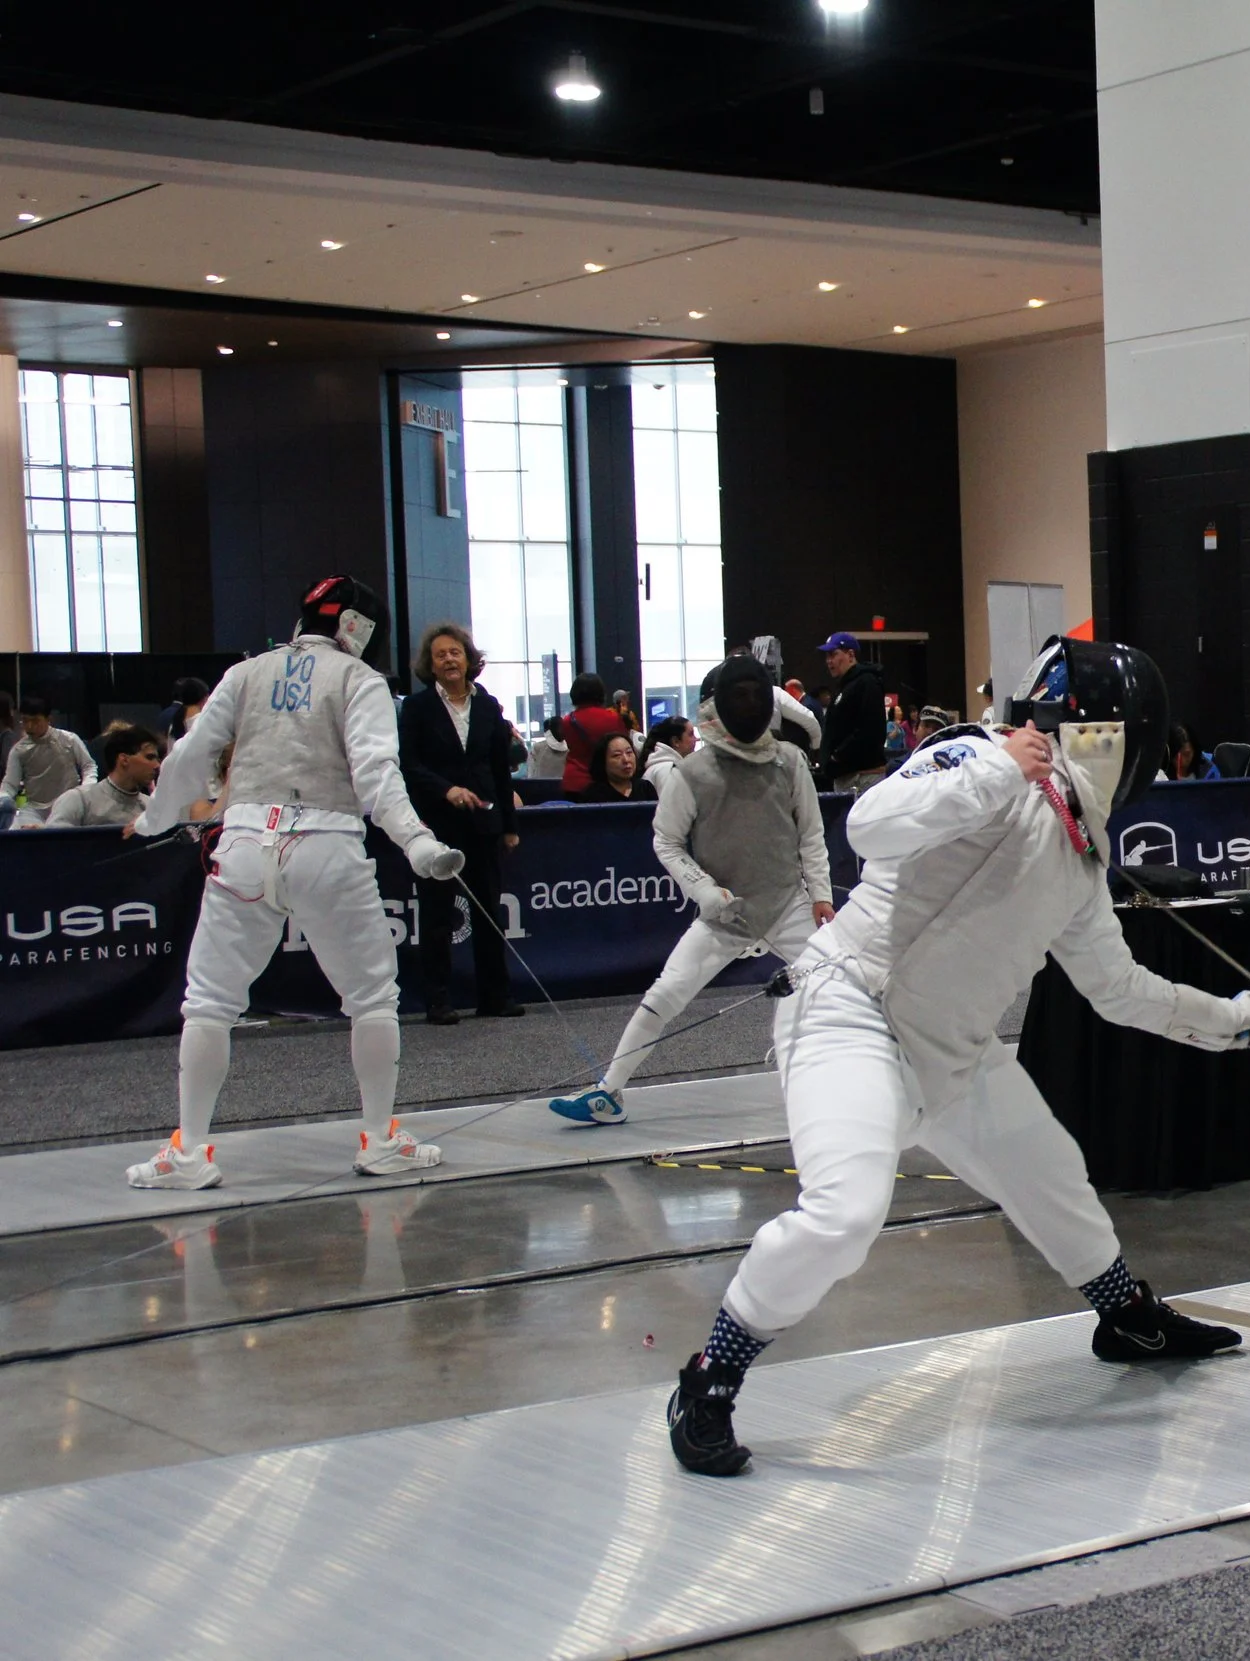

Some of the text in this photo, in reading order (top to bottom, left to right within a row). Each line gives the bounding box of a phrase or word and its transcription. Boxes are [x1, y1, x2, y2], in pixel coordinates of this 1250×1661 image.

[437, 431, 461, 518] E
[285, 654, 316, 684] VO
[271, 679, 312, 712] USA
[6, 901, 157, 941] USA
[0, 941, 173, 966] ARAFENCING
